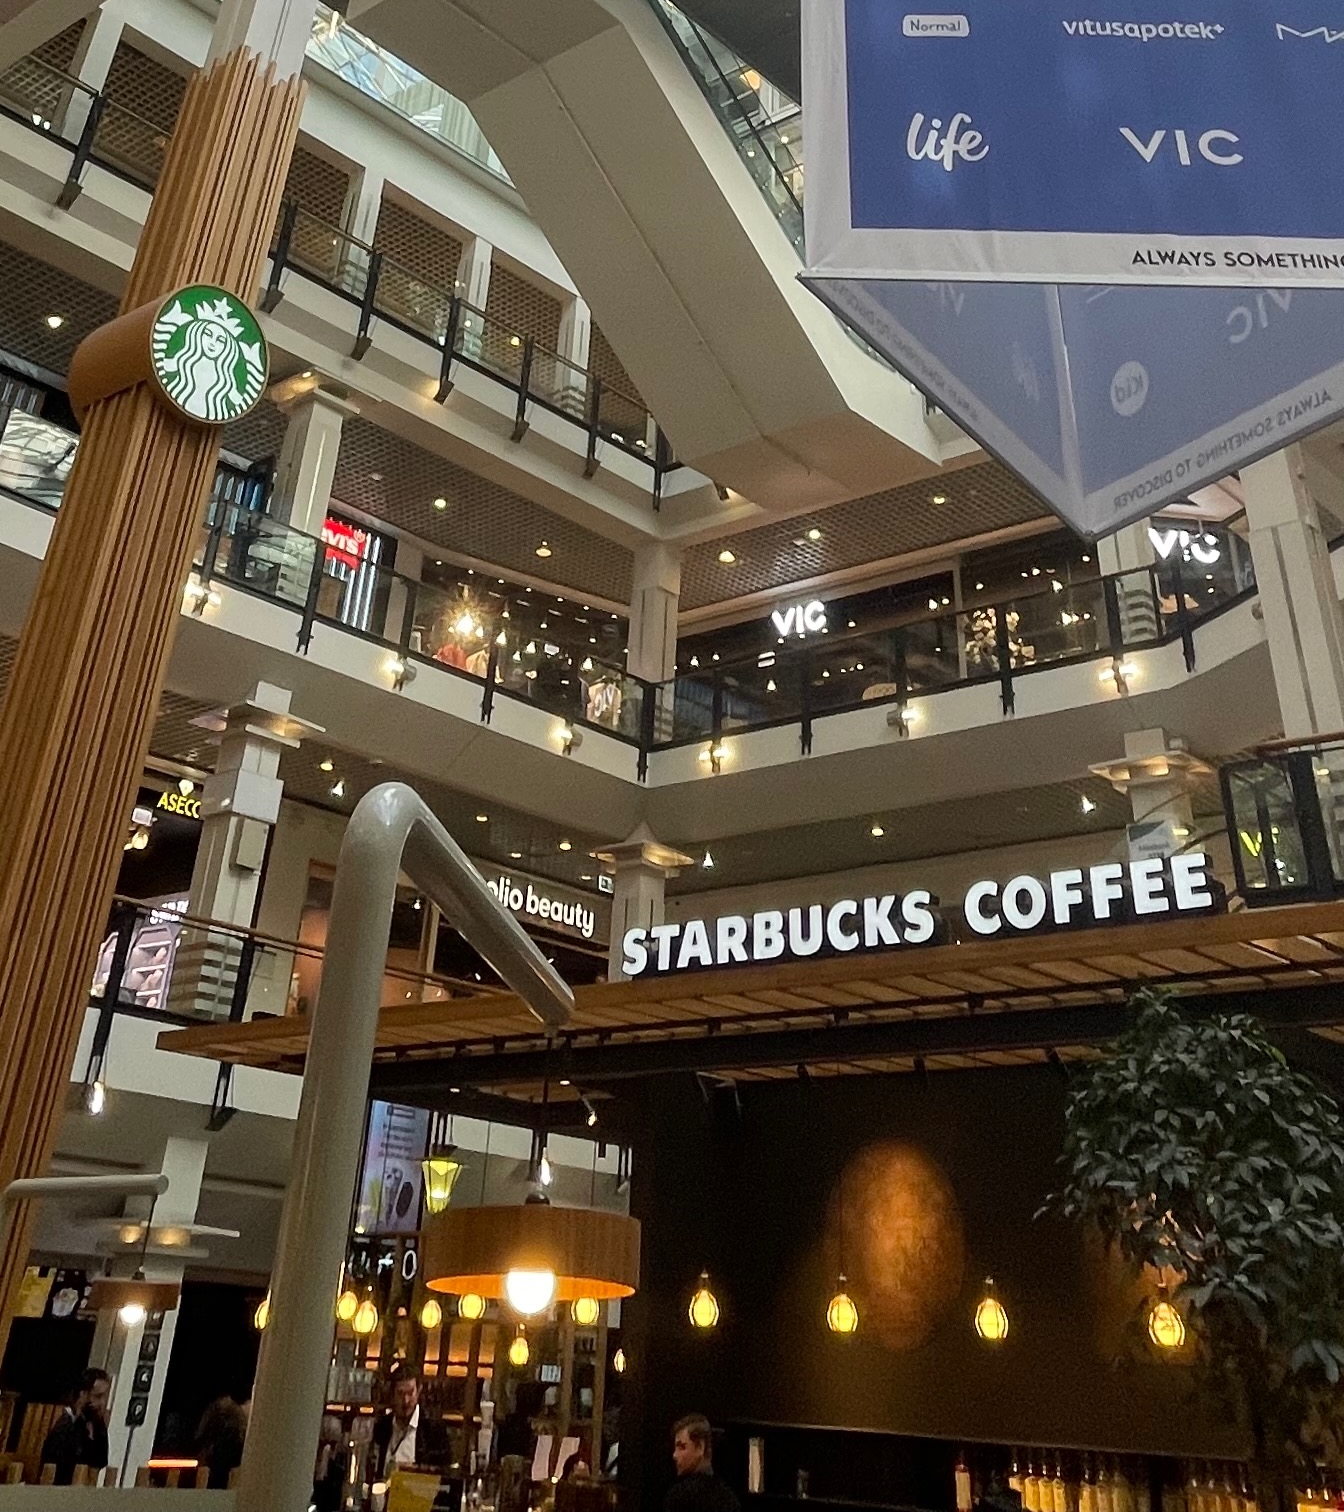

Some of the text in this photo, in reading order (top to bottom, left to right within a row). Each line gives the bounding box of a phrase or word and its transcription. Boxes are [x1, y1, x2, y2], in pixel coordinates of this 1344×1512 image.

[909, 19, 961, 33] Normal
[906, 112, 990, 172] life
[1119, 126, 1244, 166] VIC
[1131, 249, 1217, 268] ALWAYS
[1146, 526, 1221, 564] VIC
[771, 600, 827, 637] VIC
[525, 884, 595, 939] beauty
[622, 852, 1213, 977] STARBUCKS COFFEE
